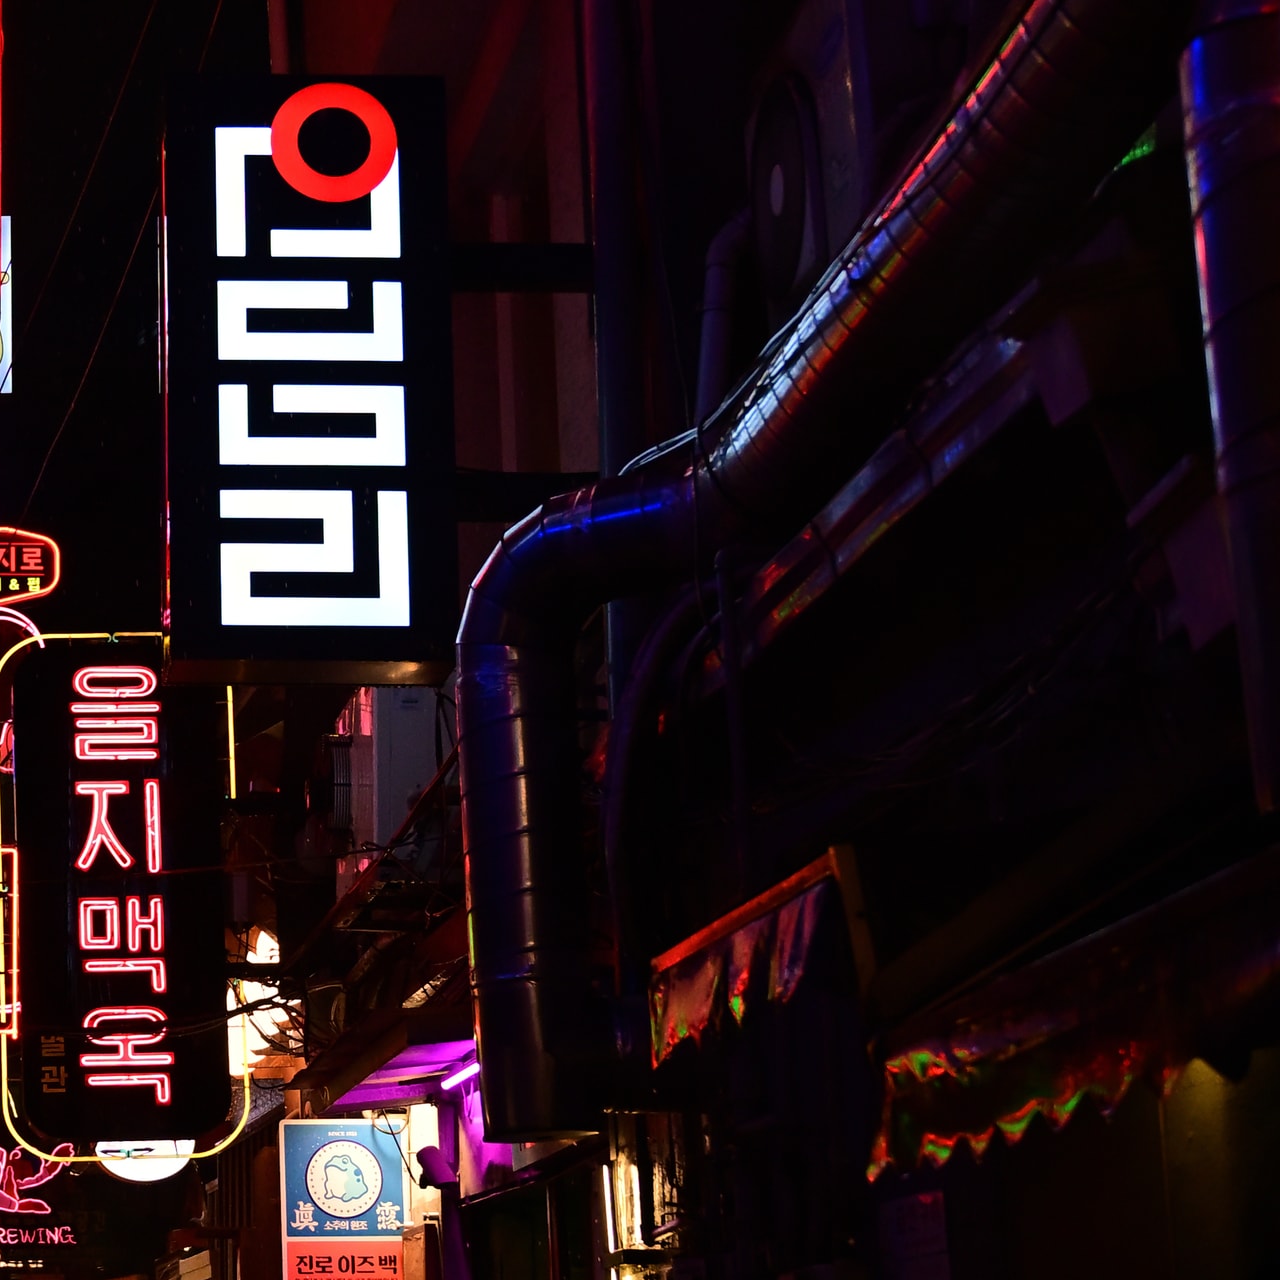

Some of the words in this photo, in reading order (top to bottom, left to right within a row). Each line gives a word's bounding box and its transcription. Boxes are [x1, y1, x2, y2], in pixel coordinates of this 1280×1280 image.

[70, 665, 176, 1106] 을지맥옥
[323, 1219, 350, 1231] 소주의
[295, 1254, 334, 1275] 진로
[337, 1254, 376, 1275] 이즈
[378, 1254, 399, 1275] 백
